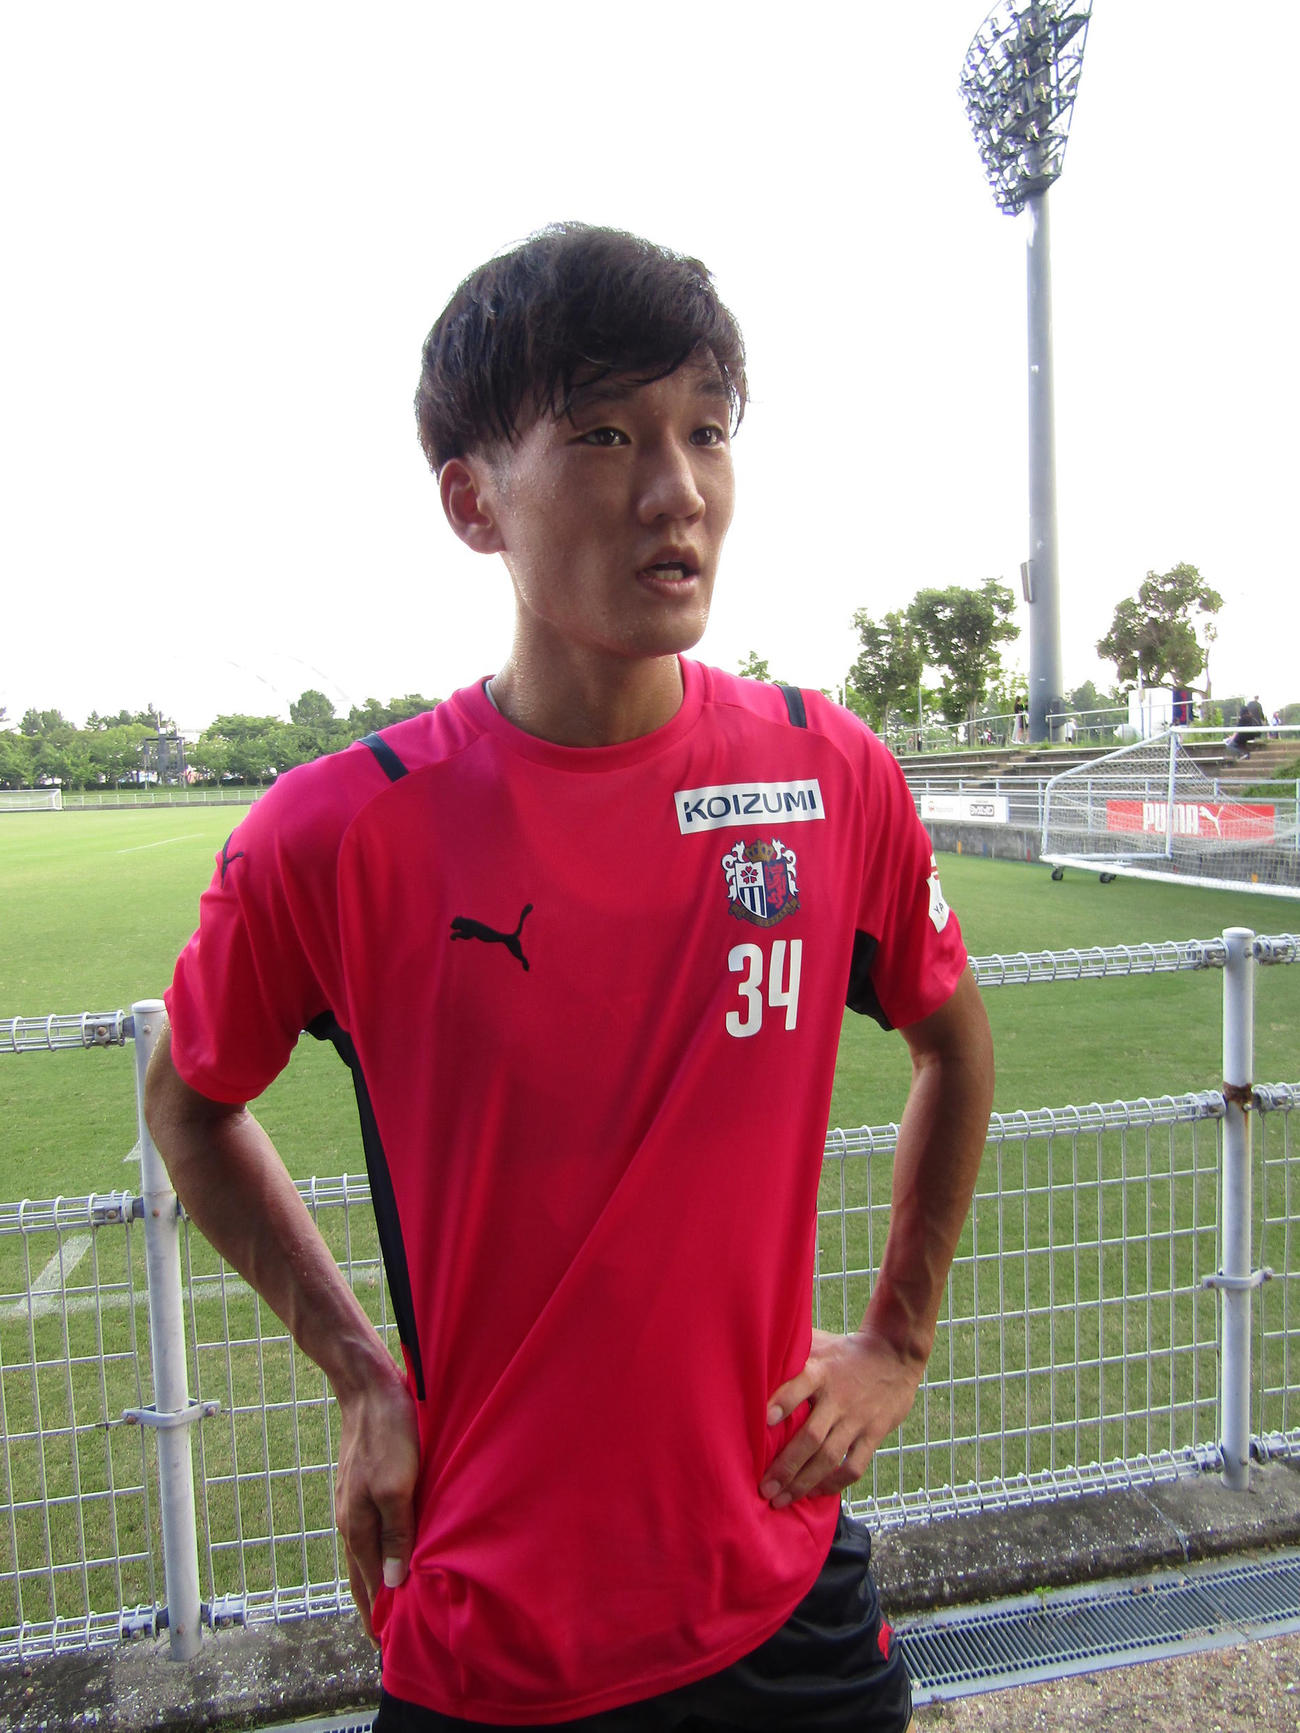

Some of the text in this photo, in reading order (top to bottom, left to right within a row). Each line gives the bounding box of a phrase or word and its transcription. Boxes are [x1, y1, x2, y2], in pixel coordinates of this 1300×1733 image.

[683, 790, 817, 823] KOIZUMI
[1143, 803, 1199, 834] PUMA
[725, 939, 803, 1038] 34
